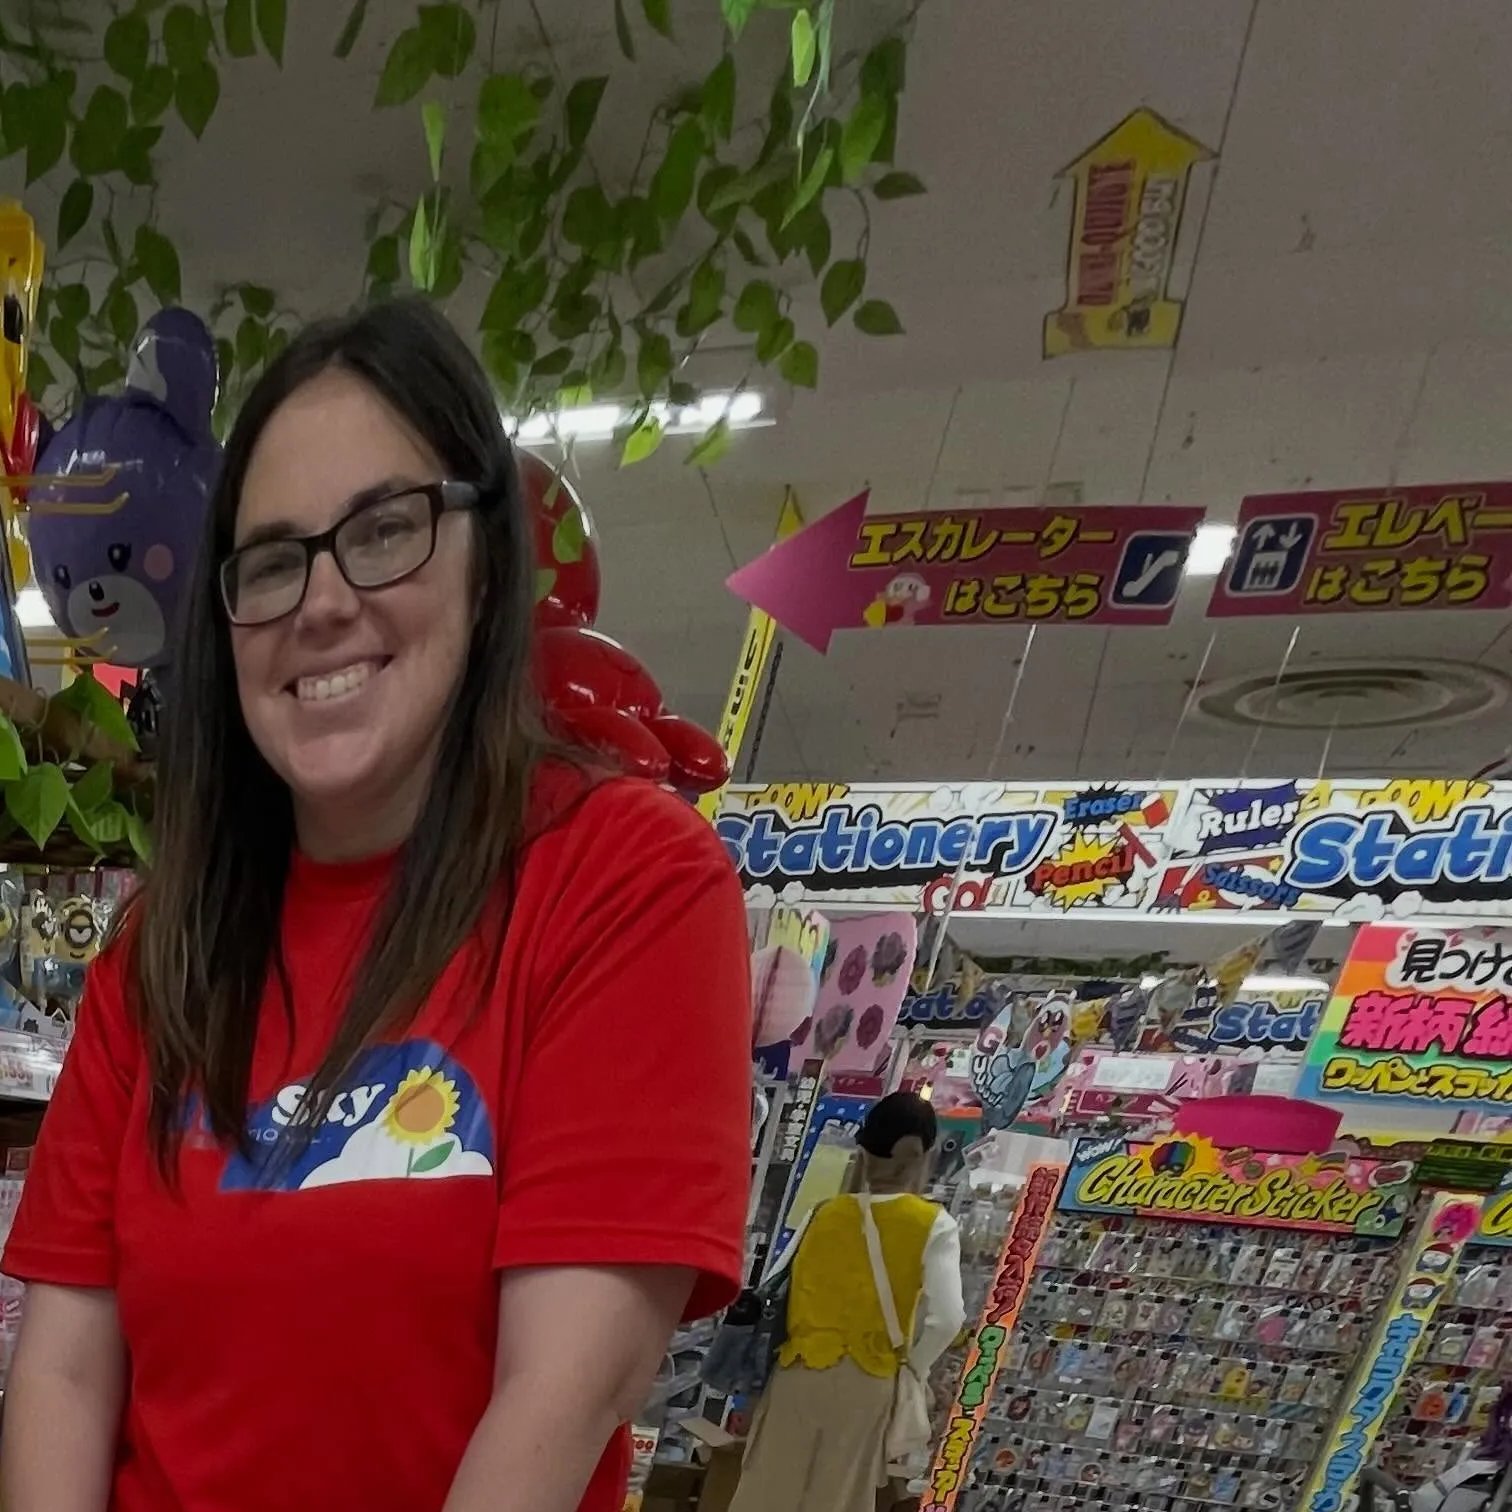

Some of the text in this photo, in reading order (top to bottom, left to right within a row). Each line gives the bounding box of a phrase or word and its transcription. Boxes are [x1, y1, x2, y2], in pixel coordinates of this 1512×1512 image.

[849, 516, 1116, 569] エスカレーター
[945, 574, 1105, 618] はこちら
[1305, 555, 1491, 605] はこちら
[719, 804, 1052, 877] Stationery
[1199, 798, 1300, 839] Ruler
[1034, 842, 1136, 888] Pencil
[1210, 1001, 1323, 1043] Stat
[1076, 1155, 1383, 1222] Character Sticker
